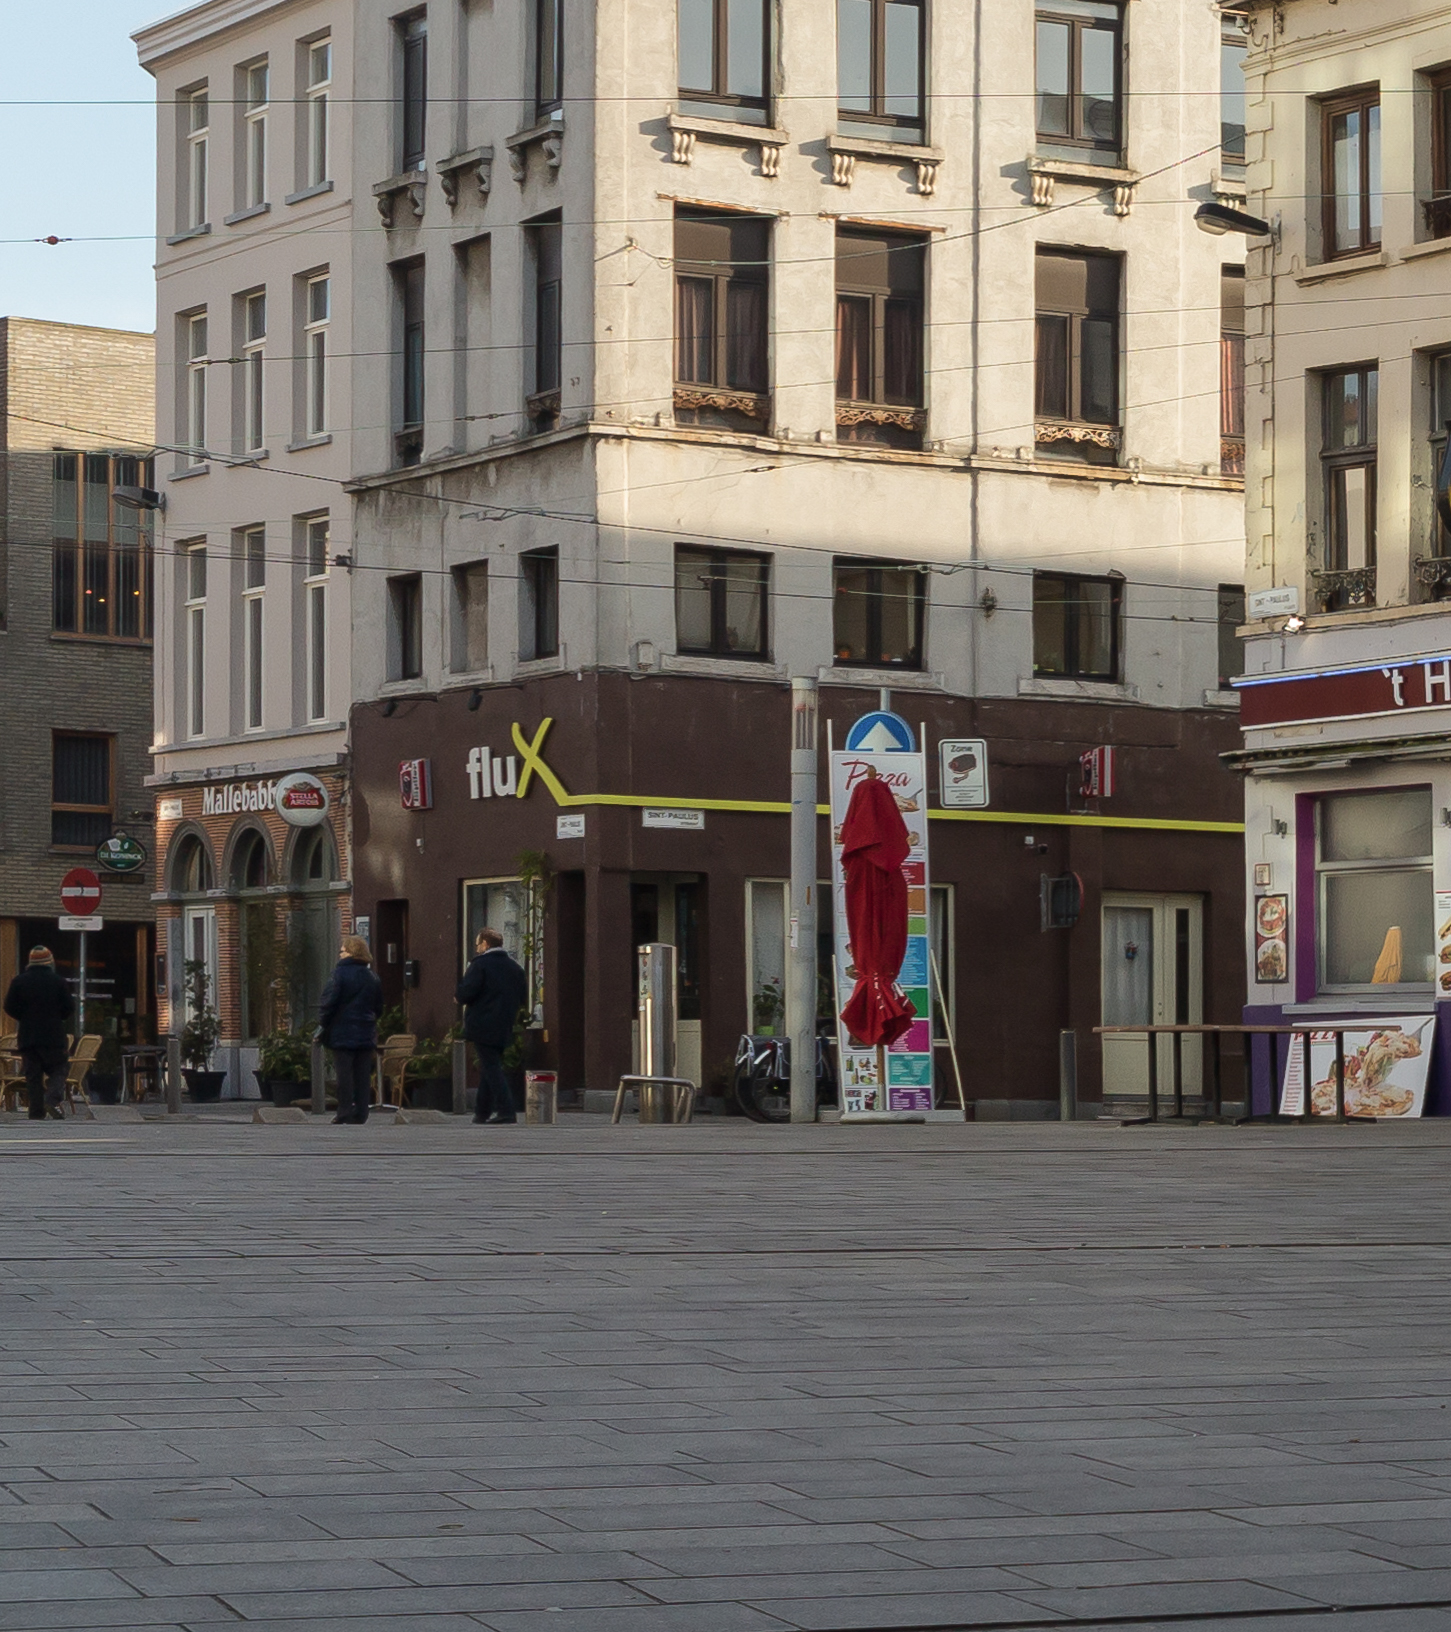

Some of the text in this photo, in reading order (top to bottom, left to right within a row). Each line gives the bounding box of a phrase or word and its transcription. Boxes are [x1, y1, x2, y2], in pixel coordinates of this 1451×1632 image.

[951, 745, 973, 753] Zone
[841, 759, 911, 790] Pzza
[202, 780, 277, 815] Mallebabb
